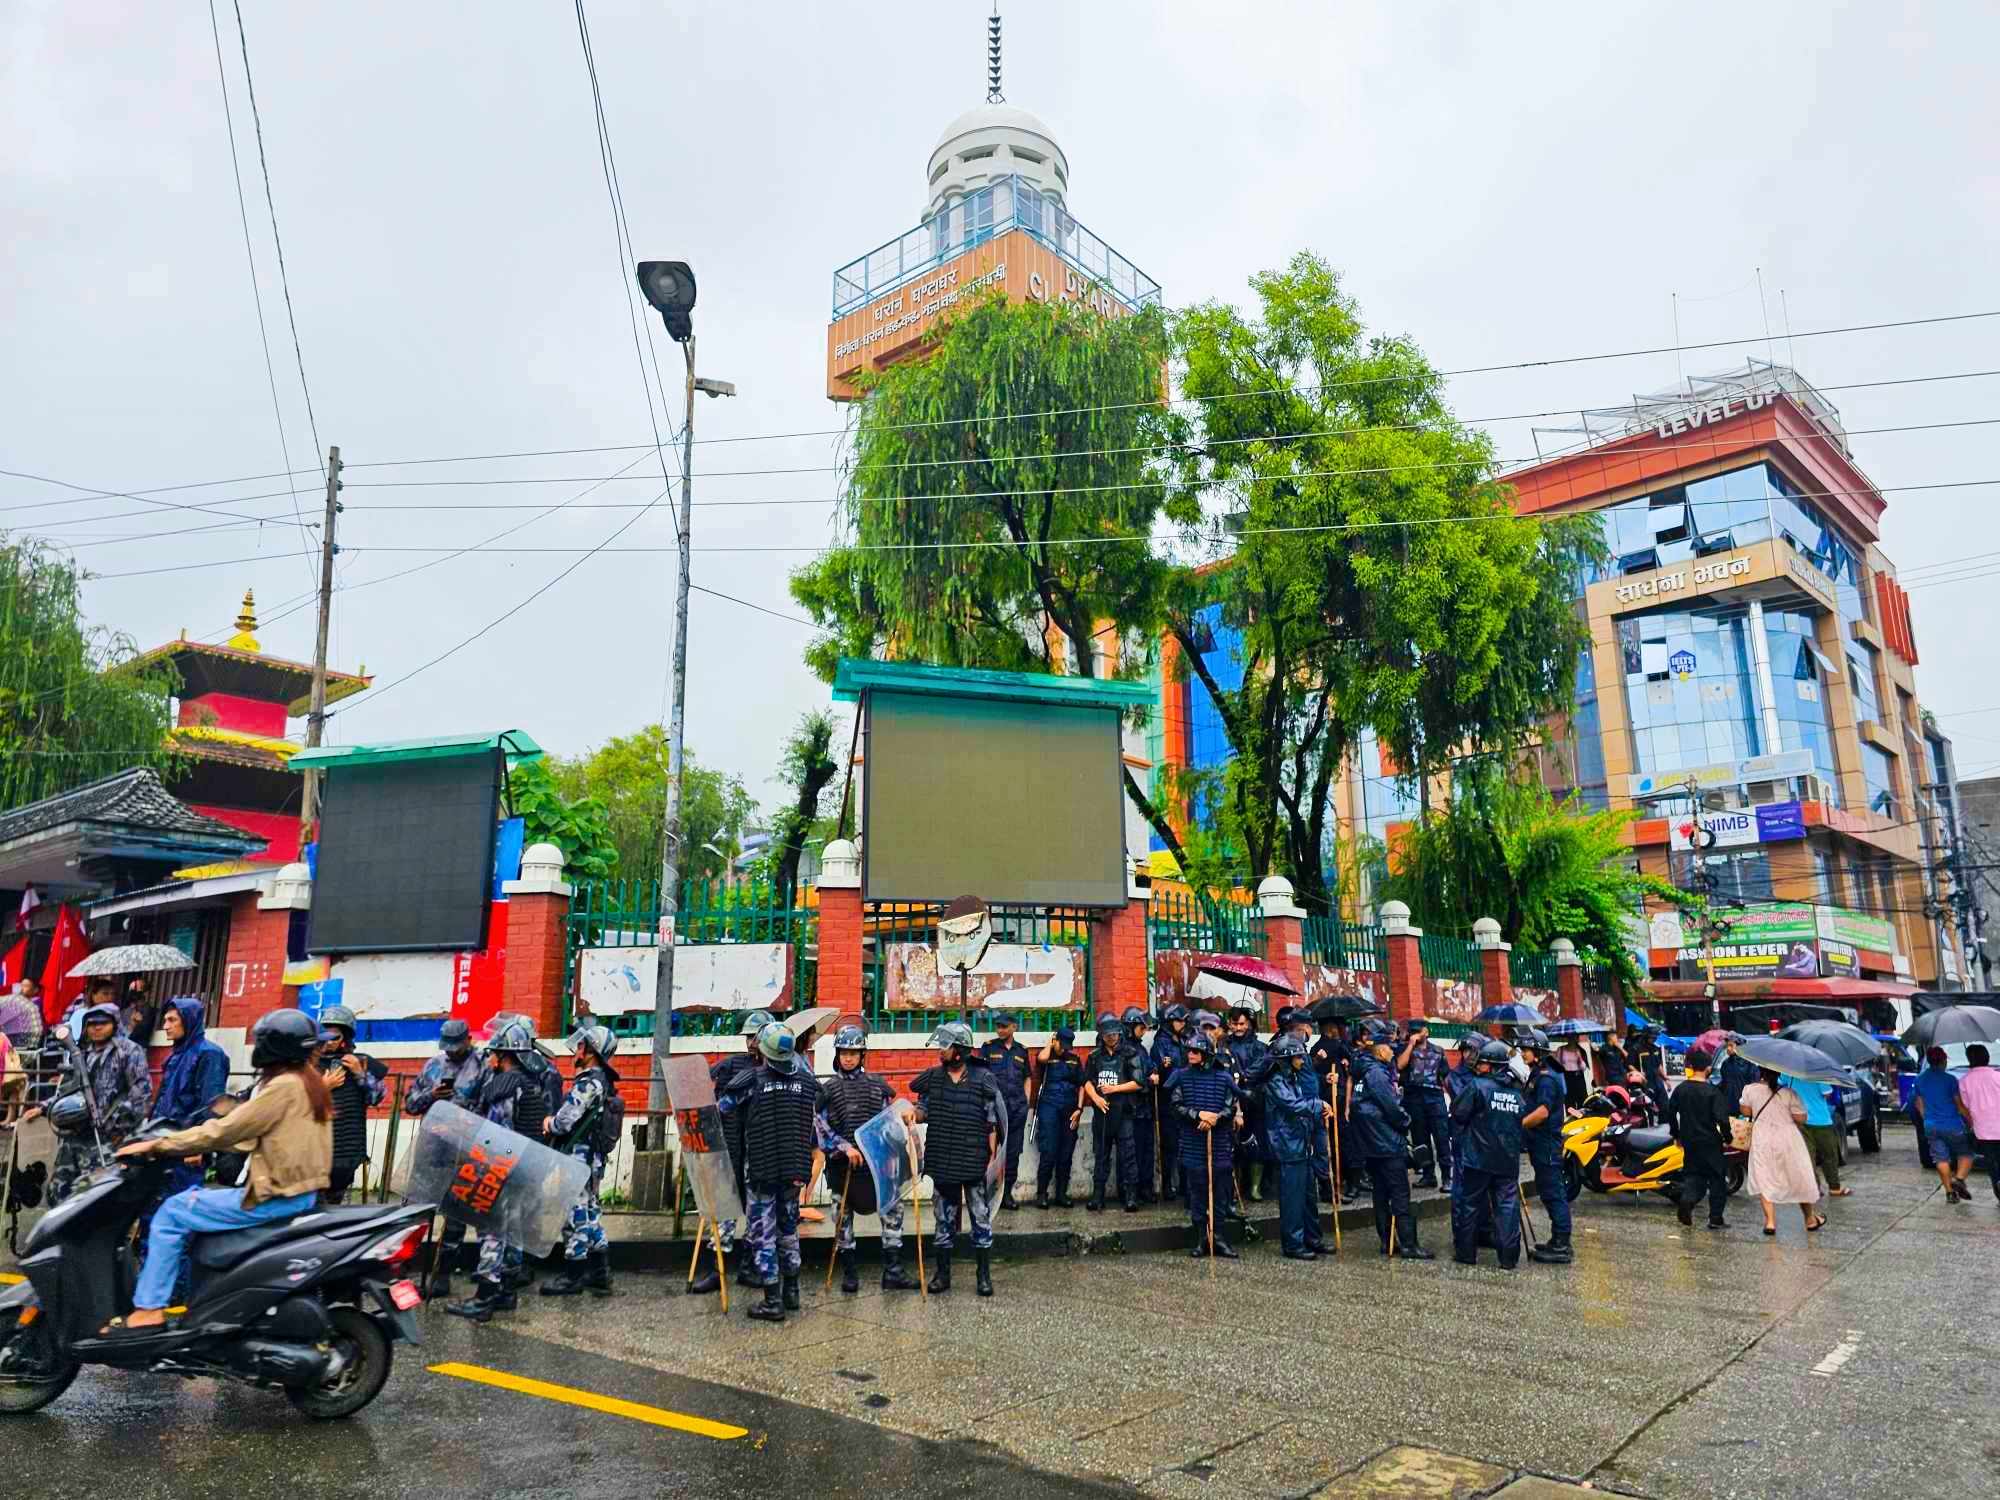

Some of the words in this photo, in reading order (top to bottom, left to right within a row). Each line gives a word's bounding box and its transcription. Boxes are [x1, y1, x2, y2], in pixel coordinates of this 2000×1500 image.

[873, 297, 903, 320] धरान
[1656, 400, 1741, 438] LEVEL
[1744, 391, 1779, 411] UP
[1615, 571, 1686, 604] साधना
[1694, 555, 1752, 585] भवन
[1703, 815, 1749, 832] NIMB
[1739, 943, 1788, 957] FEVER
[1098, 1070, 1118, 1078] NEPAL
[1097, 1078, 1118, 1086] POLICE
[1493, 1091, 1517, 1103] NEPAL
[1491, 1101, 1520, 1114] POLICE
[469, 1154, 519, 1214] NEPAL
